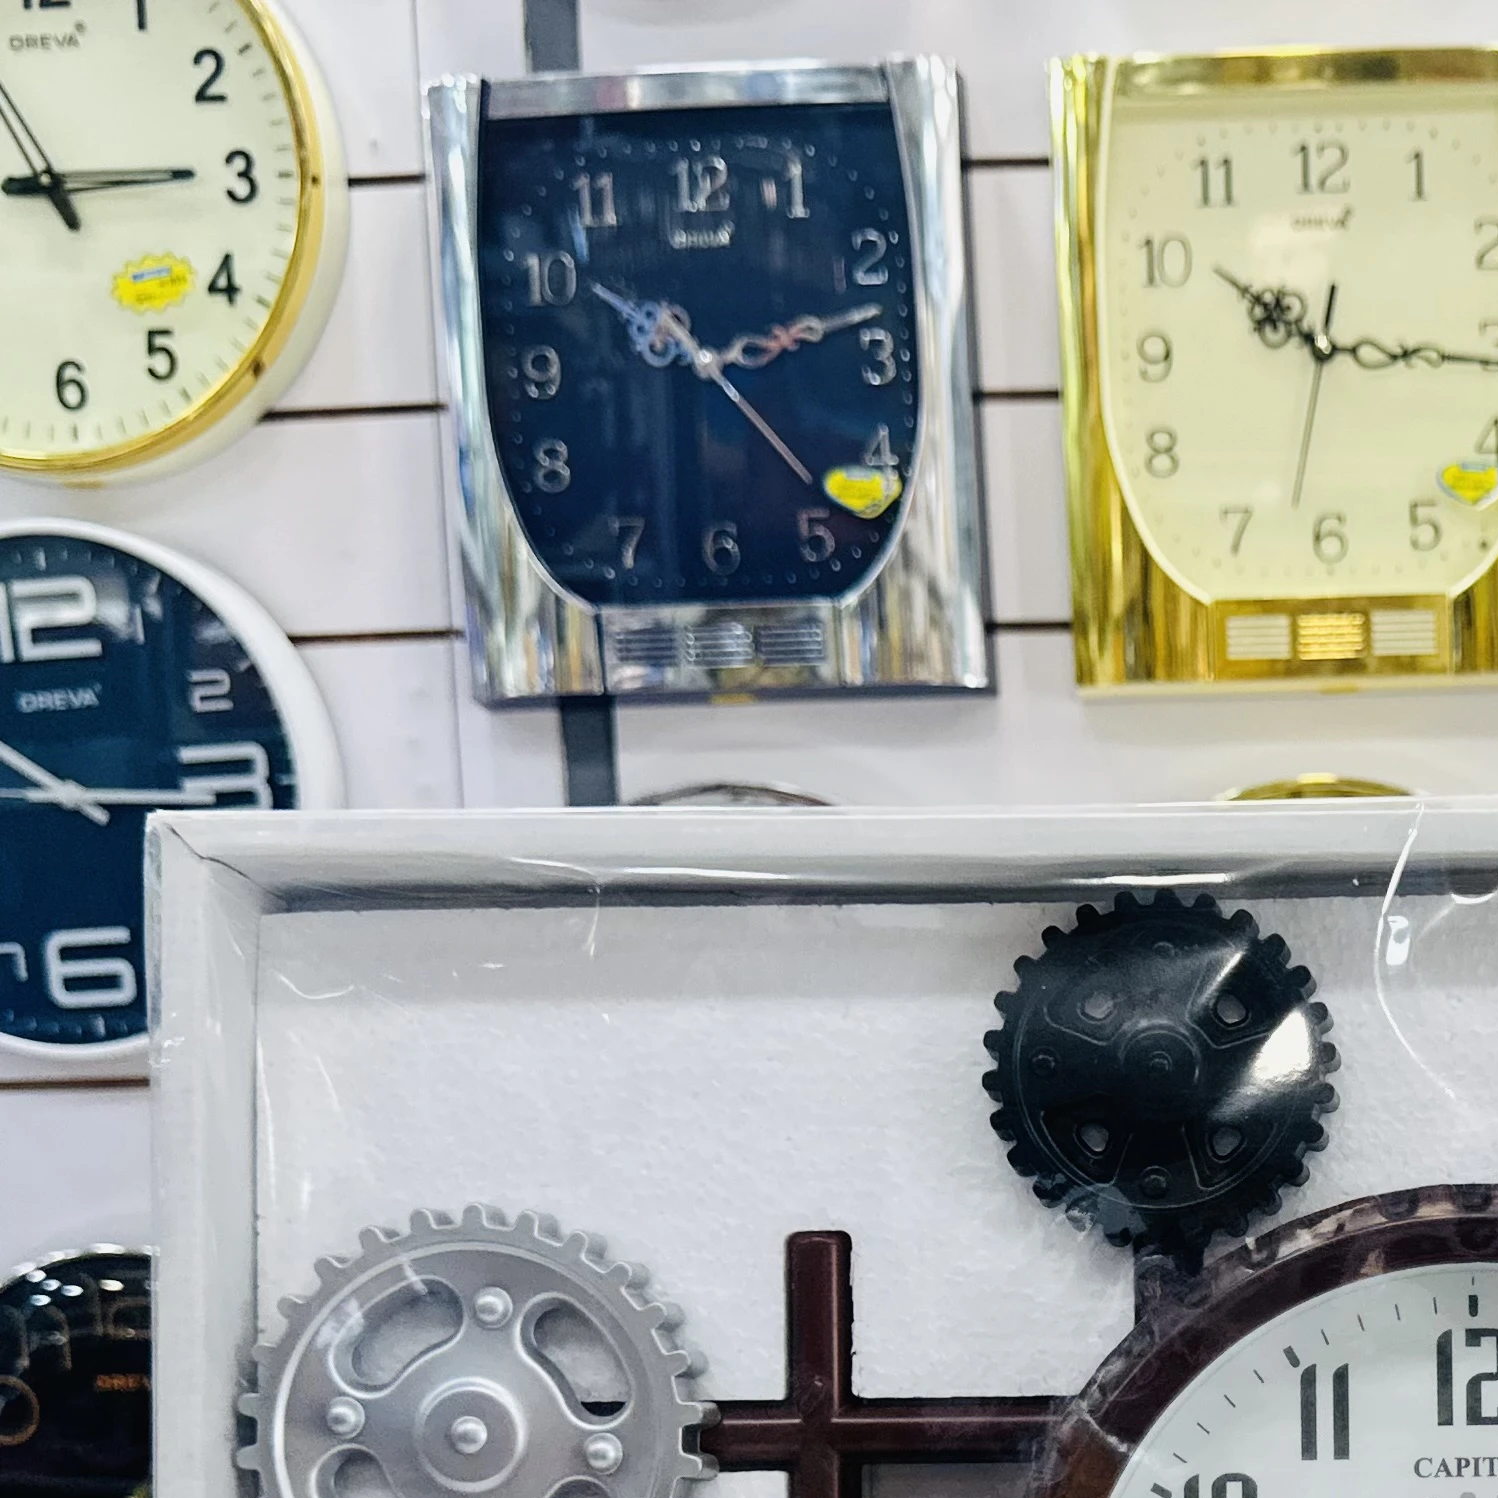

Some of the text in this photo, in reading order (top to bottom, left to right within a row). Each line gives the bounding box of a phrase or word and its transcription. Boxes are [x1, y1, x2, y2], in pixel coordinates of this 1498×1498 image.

[9, 33, 80, 51] OREVA
[192, 48, 228, 104] 2
[223, 149, 260, 205] 3
[671, 155, 730, 212] 12
[785, 155, 811, 218] 1
[1193, 155, 1236, 208] 11
[1291, 140, 1351, 196] 12
[1405, 150, 1429, 201] 1
[572, 172, 616, 227] 11
[207, 253, 241, 306] 4
[521, 250, 577, 306] 10
[851, 228, 889, 286] 2
[1137, 235, 1194, 289] 10
[145, 330, 178, 381] 5
[522, 344, 562, 399] 9
[859, 327, 896, 386] 3
[1136, 333, 1174, 384] 9
[55, 360, 88, 411] 6
[533, 440, 571, 493] 8
[863, 423, 900, 480] 4
[1144, 428, 1180, 479] 8
[609, 516, 645, 568] 7
[703, 521, 742, 575] 6
[797, 509, 836, 562] 5
[1220, 505, 1254, 557] 7
[1312, 511, 1349, 565] 6
[1408, 500, 1443, 552] 5
[17, 686, 99, 713] OREVA
[187, 669, 234, 713] 2
[45, 925, 138, 1009] 6
[1300, 1363, 1350, 1460] 11
